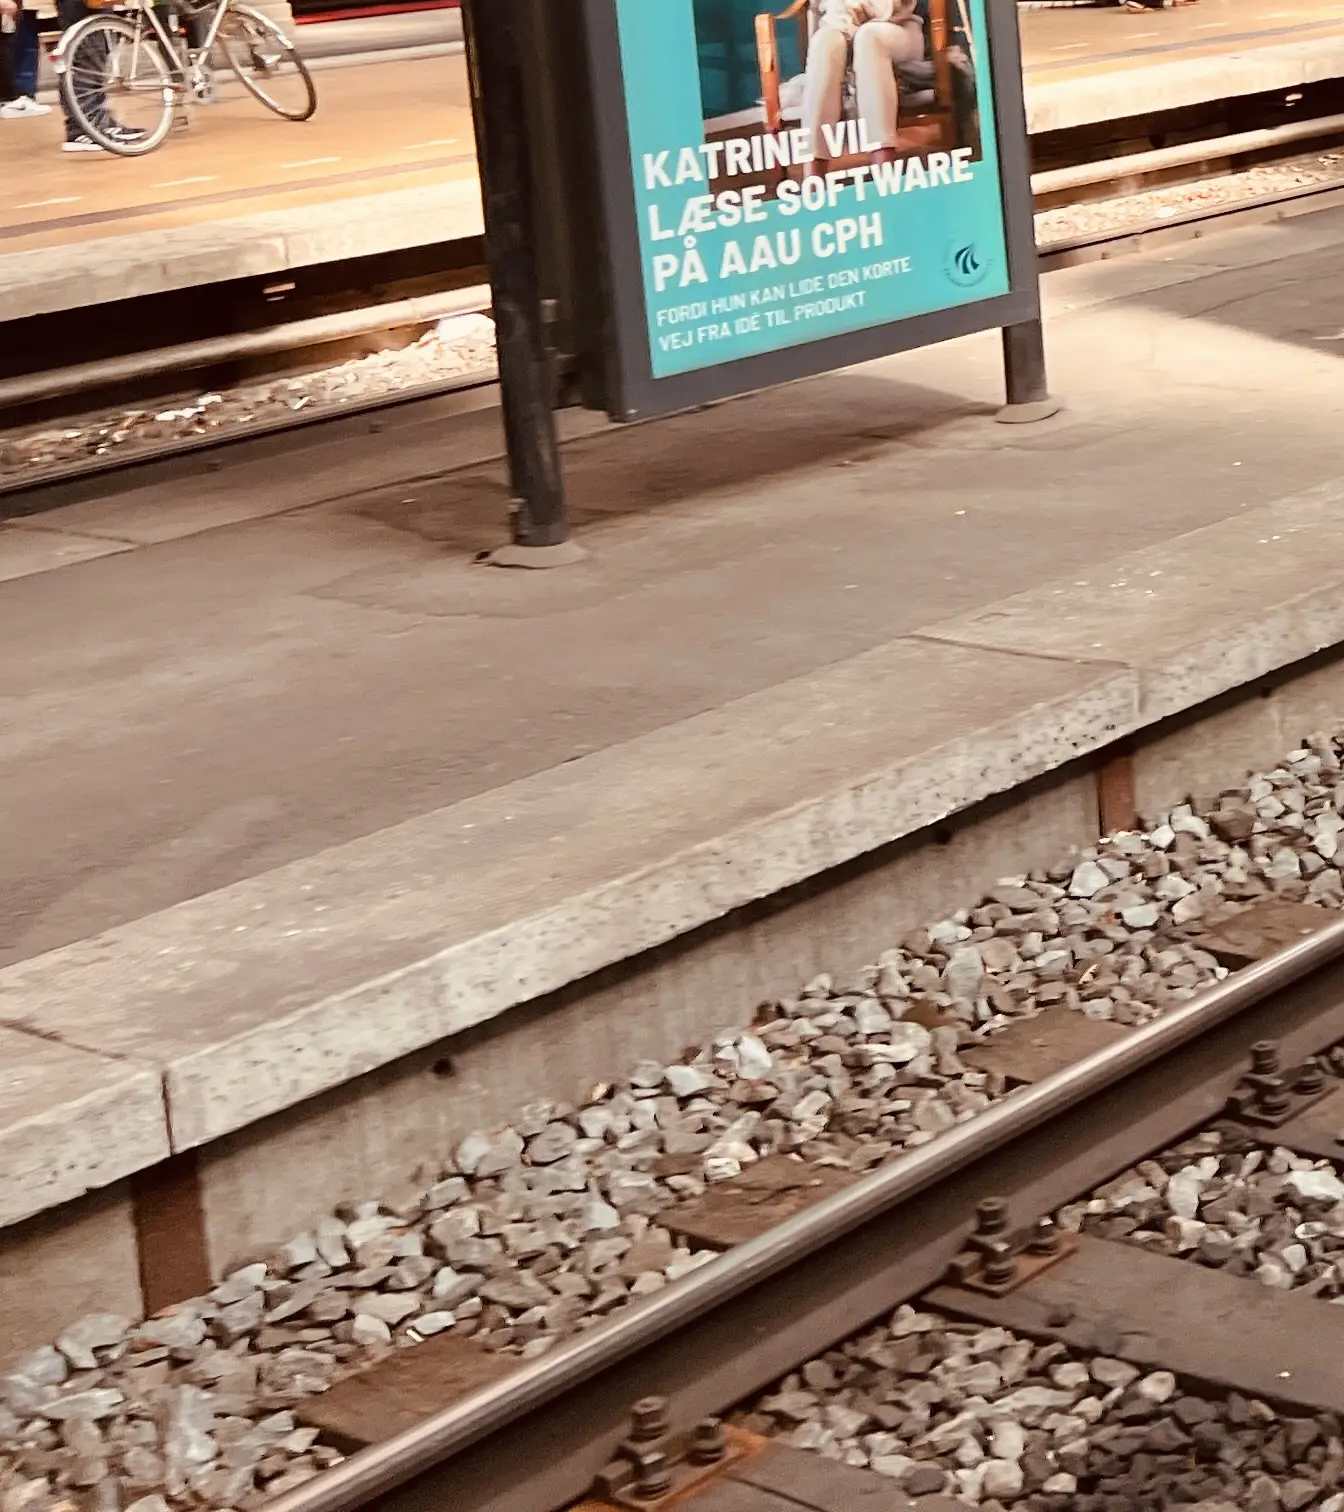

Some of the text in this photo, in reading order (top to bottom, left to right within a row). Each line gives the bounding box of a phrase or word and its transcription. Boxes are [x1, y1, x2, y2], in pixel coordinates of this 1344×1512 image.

[643, 118, 881, 190] KATRINE VIL
[648, 147, 974, 241] LÆSE SOFTWARE
[653, 212, 885, 292] PÅ AAU CPH
[656, 256, 912, 327] FORDI HUN KAN LIDE DEN KORTE
[658, 330, 693, 351] VEJ
[697, 322, 731, 343] FRA
[764, 309, 791, 328] TIL
[794, 291, 867, 321] PRODUKT
